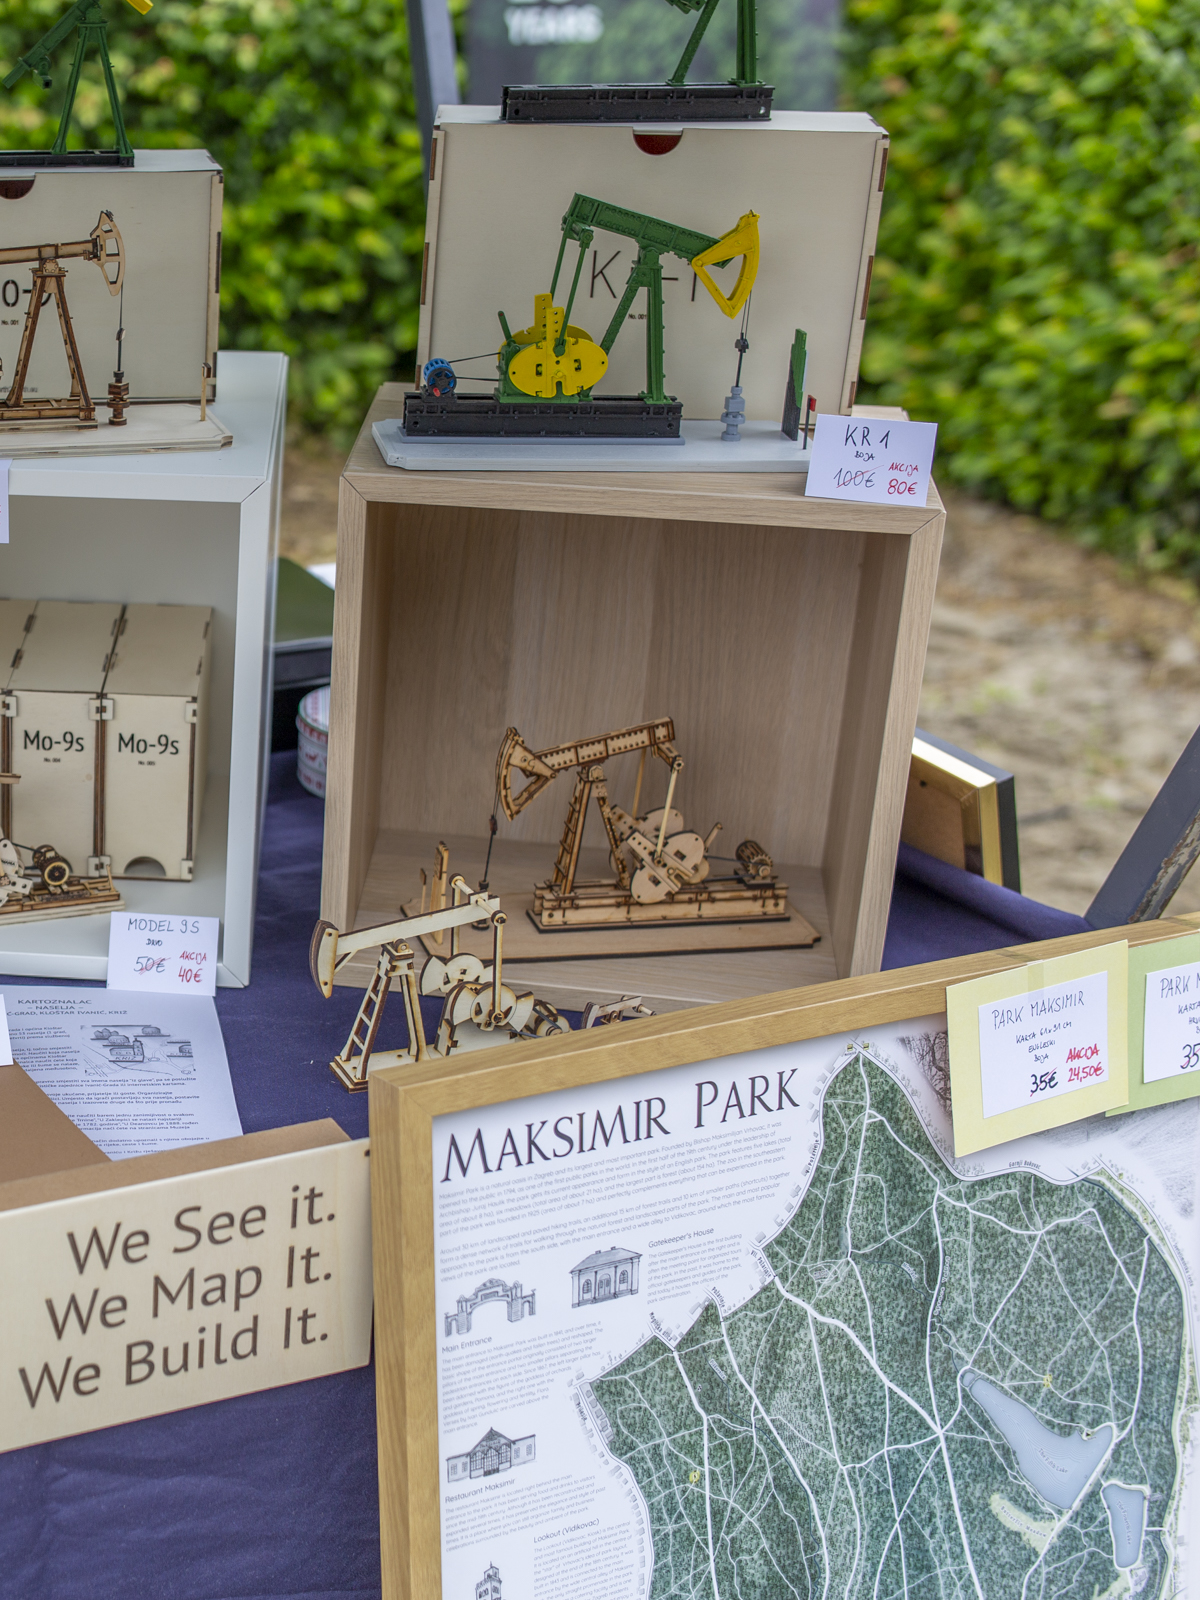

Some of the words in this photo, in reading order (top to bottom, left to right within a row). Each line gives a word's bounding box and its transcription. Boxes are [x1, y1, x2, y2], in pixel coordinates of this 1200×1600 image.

[503, 4, 603, 45] YEARS
[845, 424, 871, 446] KR
[880, 430, 890, 449] 1
[854, 451, 875, 462] BOJA
[833, 468, 876, 488] 100€
[888, 462, 919, 477] AKCIJA
[887, 478, 918, 495] 80€
[24, 729, 85, 752] Mo-9s
[118, 733, 179, 756] Mo-9s
[128, 918, 174, 932] MODEL
[146, 938, 163, 946] DRVO
[133, 956, 166, 973] 50€
[179, 950, 207, 965] AKCIJA
[178, 966, 203, 983] 40€
[1160, 975, 1190, 998] PARK
[992, 1006, 1024, 1030] PARK
[1031, 990, 1084, 1017] MAKSIMIR
[1016, 1032, 1036, 1044] KARTA
[1028, 1040, 1055, 1053] ENGLESKI
[1034, 1053, 1049, 1063] BOJA
[1066, 1043, 1100, 1063] AKCIJA
[1068, 1062, 1104, 1082] 24,50€
[1030, 1071, 1058, 1094] 35€
[439, 1188, 465, 1200] Maksimir
[465, 1184, 479, 1194] Park
[479, 1183, 485, 1191] is
[491, 1177, 511, 1189] natural
[511, 1175, 526, 1184] oasis
[526, 1173, 533, 1181] in
[533, 1168, 554, 1180] Zagreb
[554, 1166, 566, 1175] and
[566, 1164, 574, 1172] its
[574, 1160, 593, 1171] largest
[593, 1157, 605, 1166] and
[605, 1154, 620, 1164] most
[620, 1148, 647, 1161] important
[661, 1140, 684, 1152] Founded
[685, 1139, 693, 1148] by
[693, 1135, 711, 1145] Bishop
[767, 1121, 771, 1129] it
[67, 1221, 150, 1276] We
[172, 1204, 267, 1254] See
[289, 1184, 336, 1229] it.
[648, 1233, 692, 1248] Gatekeeper's
[693, 1227, 715, 1238] House
[45, 1287, 128, 1341] We
[152, 1266, 262, 1319] Map
[286, 1245, 332, 1289] It.
[441, 1343, 460, 1354] Main
[460, 1336, 492, 1350] Entrance
[18, 1356, 101, 1409] We
[125, 1314, 259, 1387] Build
[283, 1306, 329, 1350] It.
[1056, 1465, 1068, 1473] Lake
[444, 1488, 484, 1504] Restaurant
[484, 1478, 516, 1493] Maksimir
[533, 1528, 561, 1544] Lookout
[562, 1518, 600, 1537] (Vidikovac)
[1000, 1506, 1023, 1526] Butterfly
[1025, 1523, 1047, 1538] Meadow
